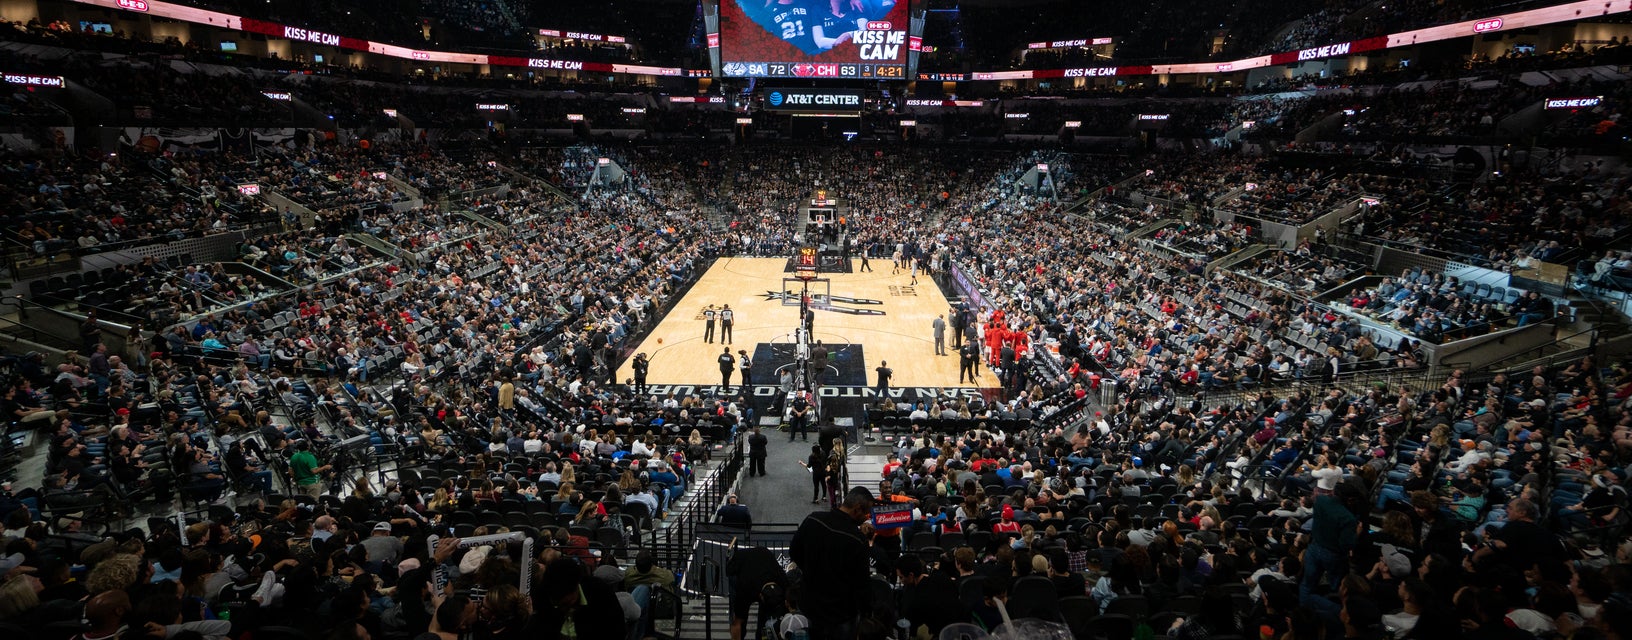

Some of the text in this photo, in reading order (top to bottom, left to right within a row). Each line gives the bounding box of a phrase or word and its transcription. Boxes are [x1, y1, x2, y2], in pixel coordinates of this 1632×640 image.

[781, 20, 805, 39] 21
[285, 26, 340, 46] KISS ME CAM
[853, 31, 884, 44] KISS
[886, 31, 906, 45] ME
[860, 44, 899, 60] CAM
[1298, 42, 1350, 60] KISS ME CAM
[528, 58, 582, 70] KISS ME CAM
[749, 65, 764, 74] SA
[771, 65, 785, 75] 72
[817, 65, 836, 76] CHI
[841, 65, 856, 76] 63
[877, 66, 903, 77] 4:21
[1064, 67, 1116, 77] KISS ME CAM
[5, 75, 60, 85] KISS ME CAM
[785, 94, 859, 105] AT&T CENTER
[1548, 98, 1598, 107] KISS ME CAM
[804, 255, 814, 264] 14
[878, 514, 910, 523] Budweiser
